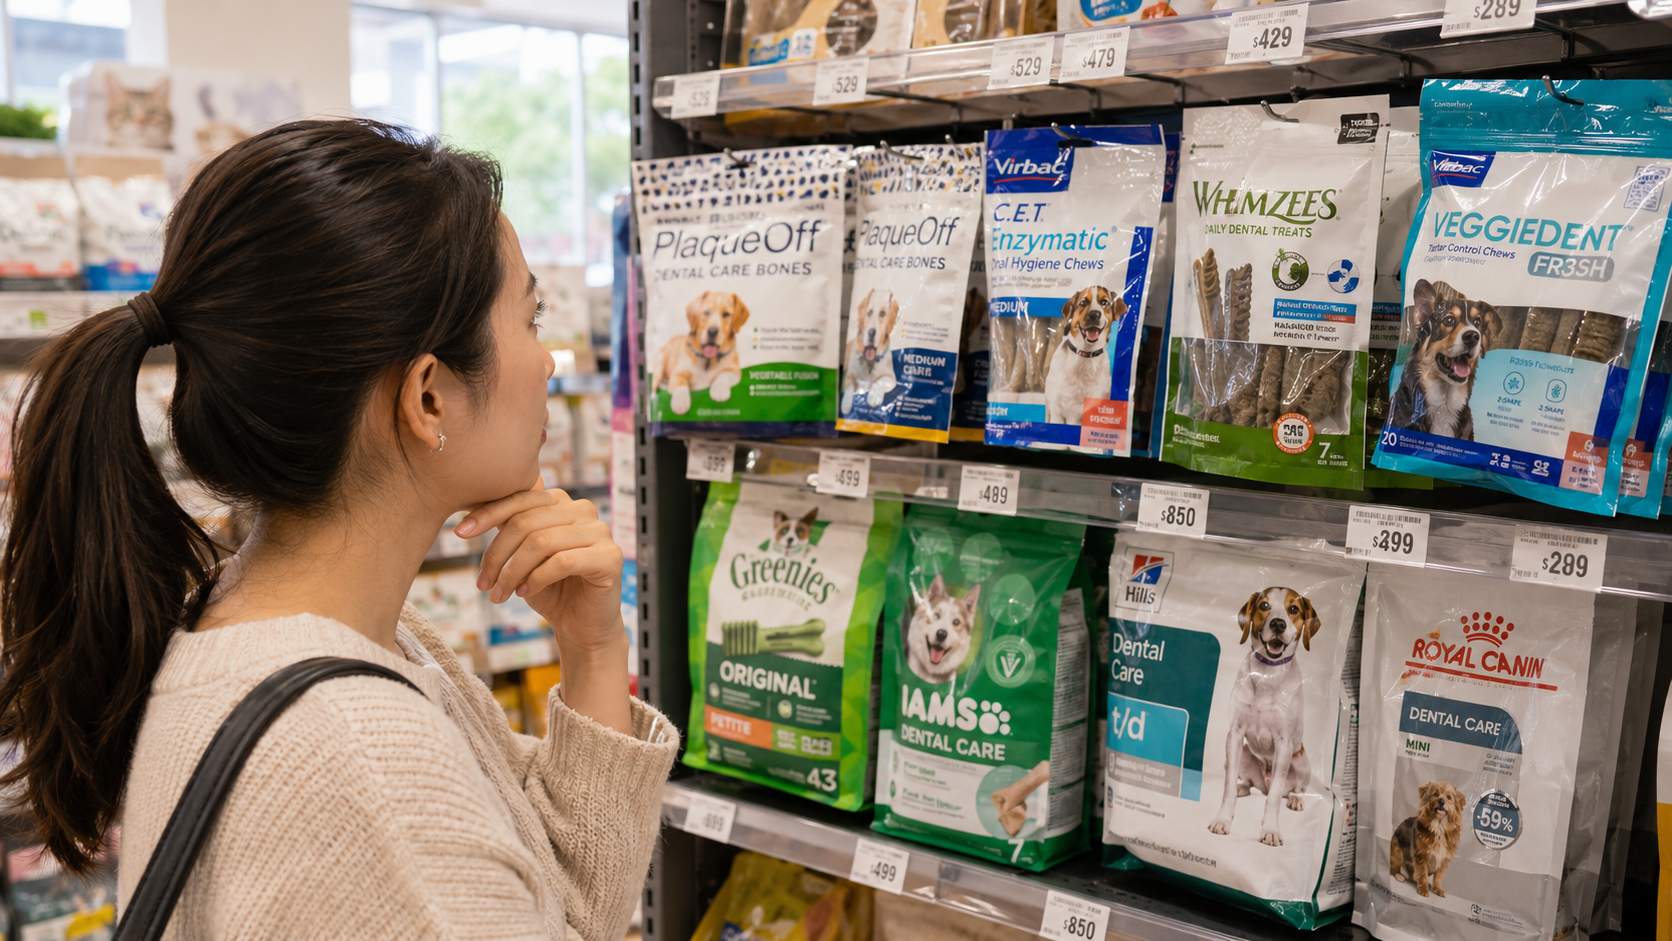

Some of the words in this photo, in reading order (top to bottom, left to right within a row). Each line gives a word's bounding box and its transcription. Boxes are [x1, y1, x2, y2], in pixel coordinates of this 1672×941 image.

[1253, 26, 1292, 50] $429
[1011, 57, 1041, 77] $529
[1082, 48, 1115, 69] $479
[994, 158, 1066, 175] Virbac
[653, 220, 822, 264] PlaqueOff
[993, 227, 1109, 256] Enzymatic
[1205, 224, 1227, 235] DAILY
[1229, 224, 1268, 236] DENTAL
[1272, 226, 1312, 238] TREATS
[1434, 211, 1624, 251] VEGGIEDENT
[881, 257, 905, 268] CARE
[907, 256, 946, 270] BONES
[1448, 243, 1482, 255] Control
[1483, 246, 1515, 259] Chews
[654, 267, 704, 282] DENTAL
[710, 264, 750, 277] CARE
[757, 262, 812, 276] BONES
[1011, 257, 1060, 272] Hygiene
[1064, 258, 1104, 270] Chews
[1533, 256, 1608, 279] FR3SH
[1318, 442, 1331, 459] 7
[1381, 431, 1397, 447] 20
[979, 485, 1008, 504] $489
[1161, 505, 1196, 527] $850
[1542, 551, 1589, 578] $289
[730, 553, 836, 604] Greenies
[1113, 633, 1165, 661] Dental
[1412, 638, 1475, 669] ROYAL
[1481, 651, 1546, 679] CANIN
[720, 660, 816, 700] ORIGINAL
[1111, 659, 1144, 685] Care
[902, 684, 978, 732] IAMS
[711, 712, 751, 735] PETITE
[1111, 706, 1147, 741] t/d
[1409, 707, 1462, 728] DENTAL
[1464, 717, 1502, 736] CARE
[901, 723, 953, 752] DENTAL
[956, 738, 1006, 761] CARE
[1406, 738, 1430, 752] MINI
[807, 768, 837, 792] 43
[1008, 838, 1025, 863] 7
[870, 861, 896, 882] $499
[1063, 916, 1096, 940] $850
